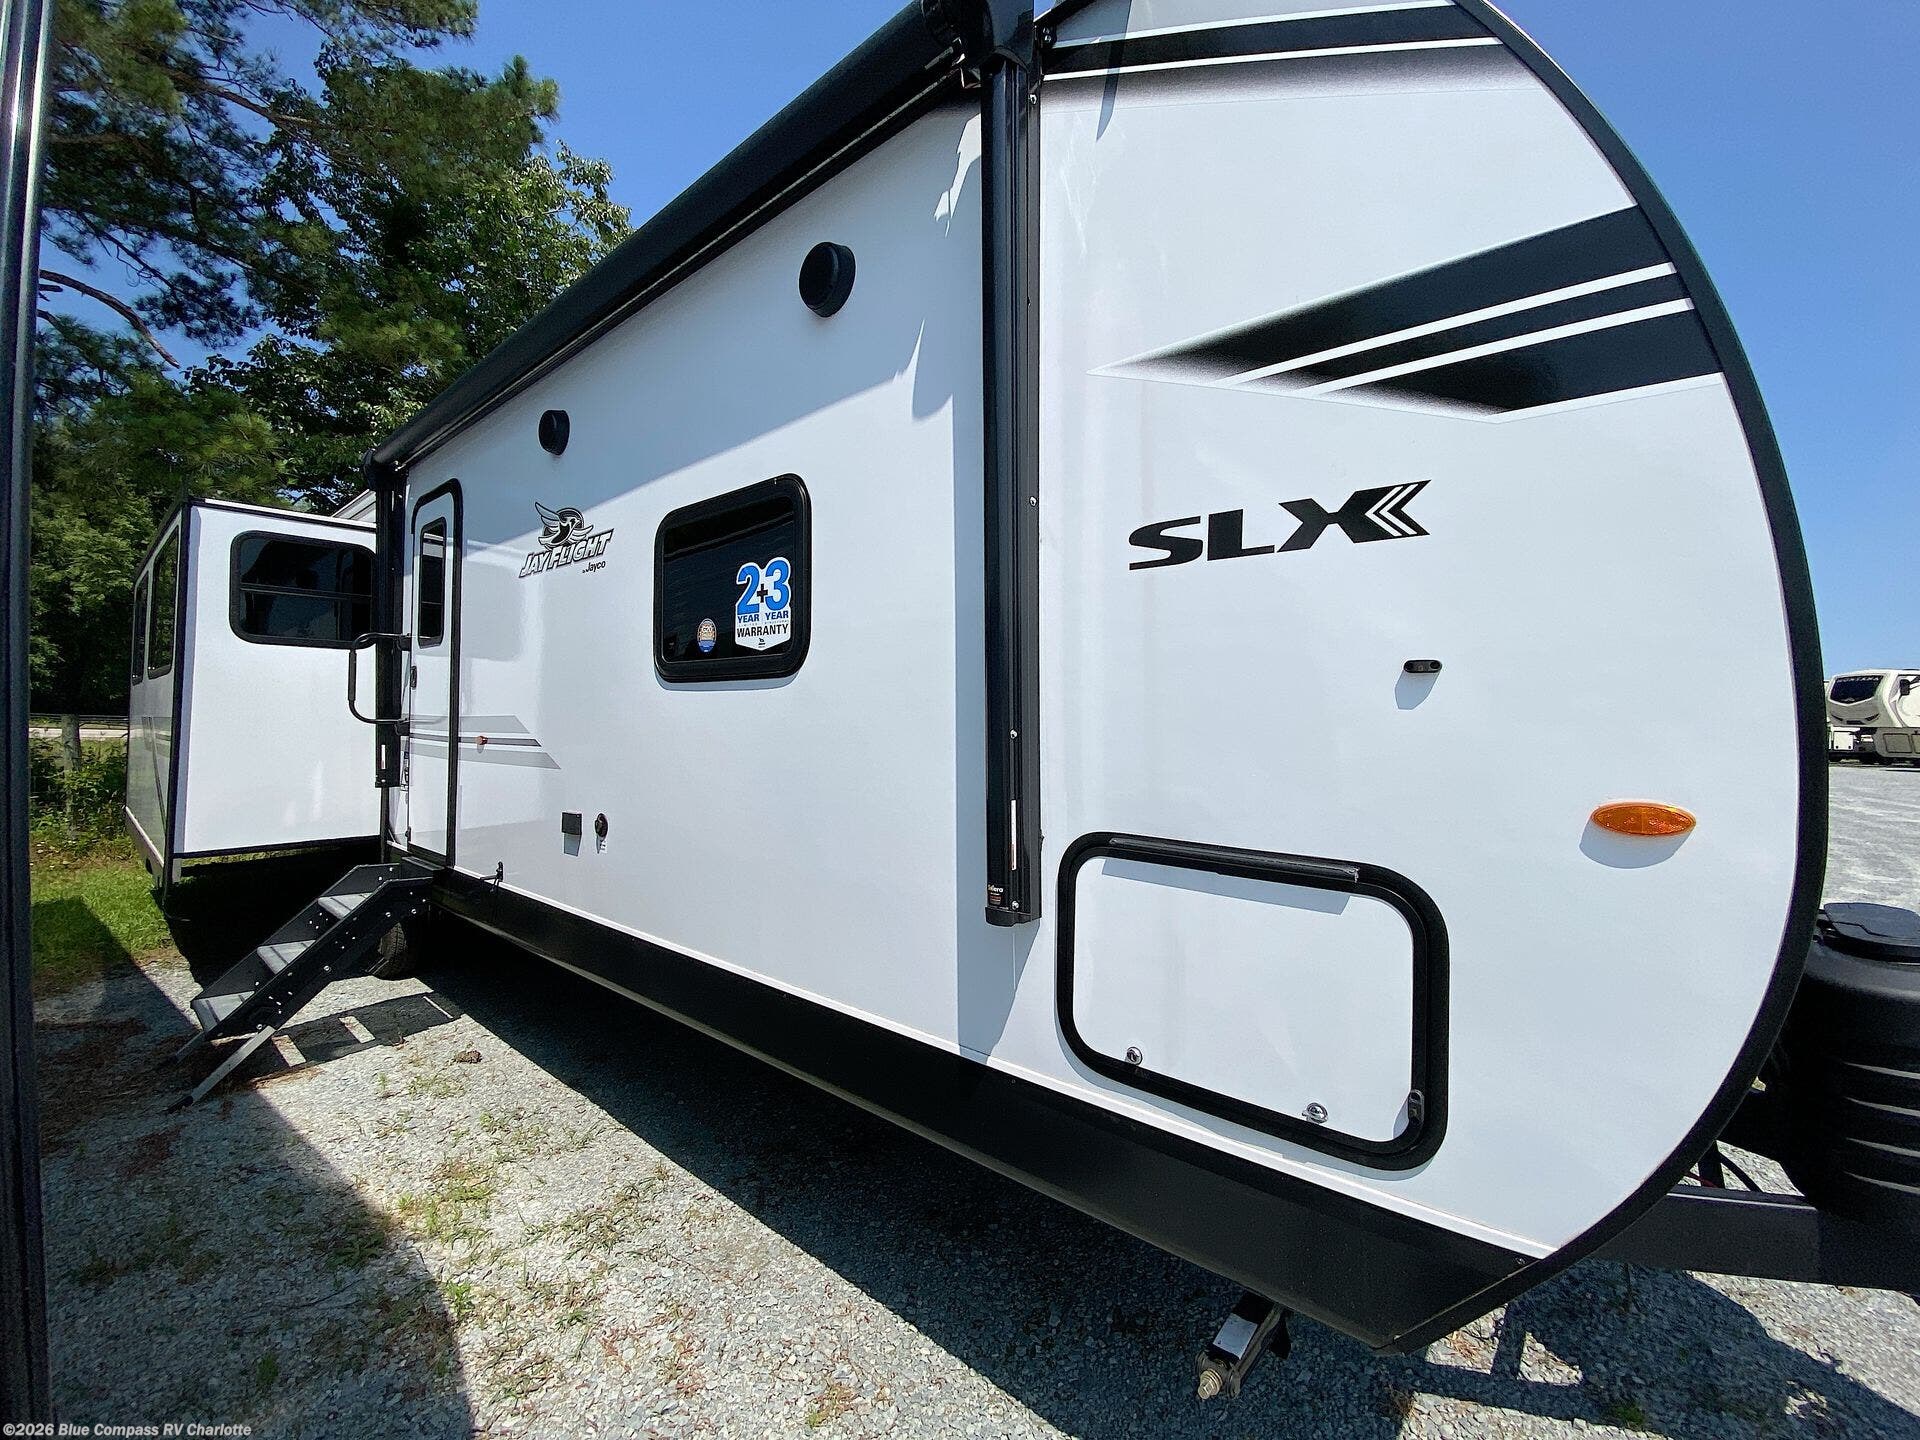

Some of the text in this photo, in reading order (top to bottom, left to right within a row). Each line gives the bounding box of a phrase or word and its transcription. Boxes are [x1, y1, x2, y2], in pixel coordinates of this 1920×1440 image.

[1128, 479, 1432, 571] SLX
[738, 614, 759, 623] YEAR
[765, 611, 789, 621] YEAR
[737, 624, 788, 638] WARRANTY
